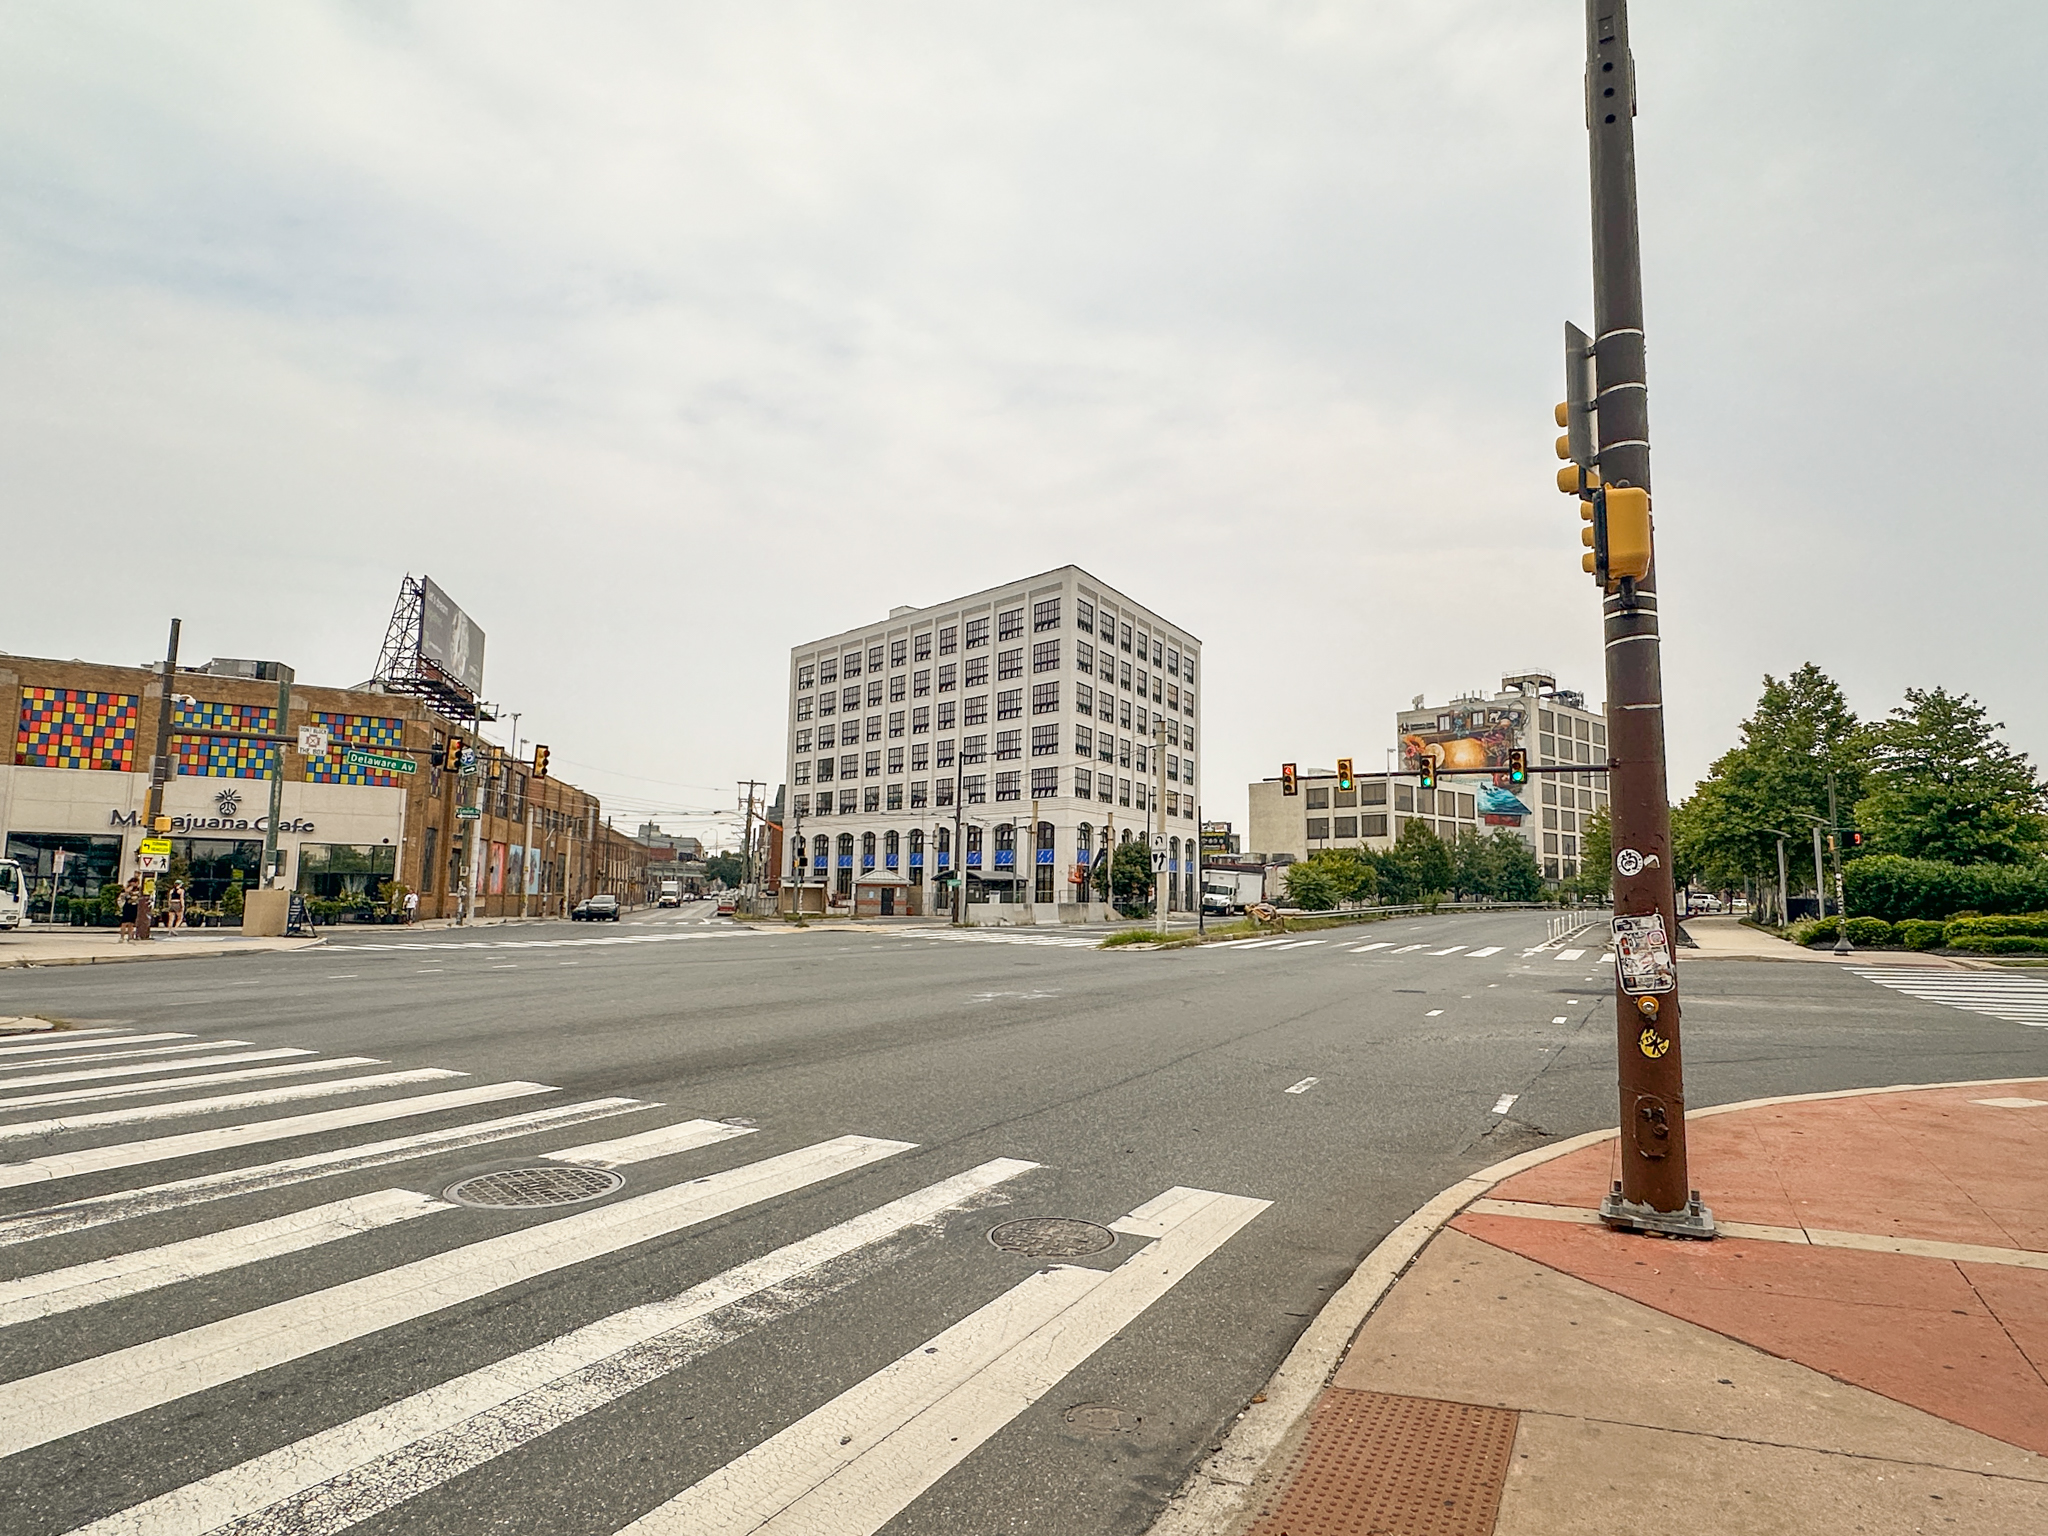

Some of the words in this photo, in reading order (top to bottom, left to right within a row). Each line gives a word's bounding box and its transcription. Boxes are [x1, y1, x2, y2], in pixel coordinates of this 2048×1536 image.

[300, 746, 310, 754] THE
[313, 748, 325, 756] BOX
[350, 753, 397, 769] Delaware
[400, 762, 414, 772] Av
[461, 752, 473, 762] 95
[1854, 832, 1861, 845] 9
